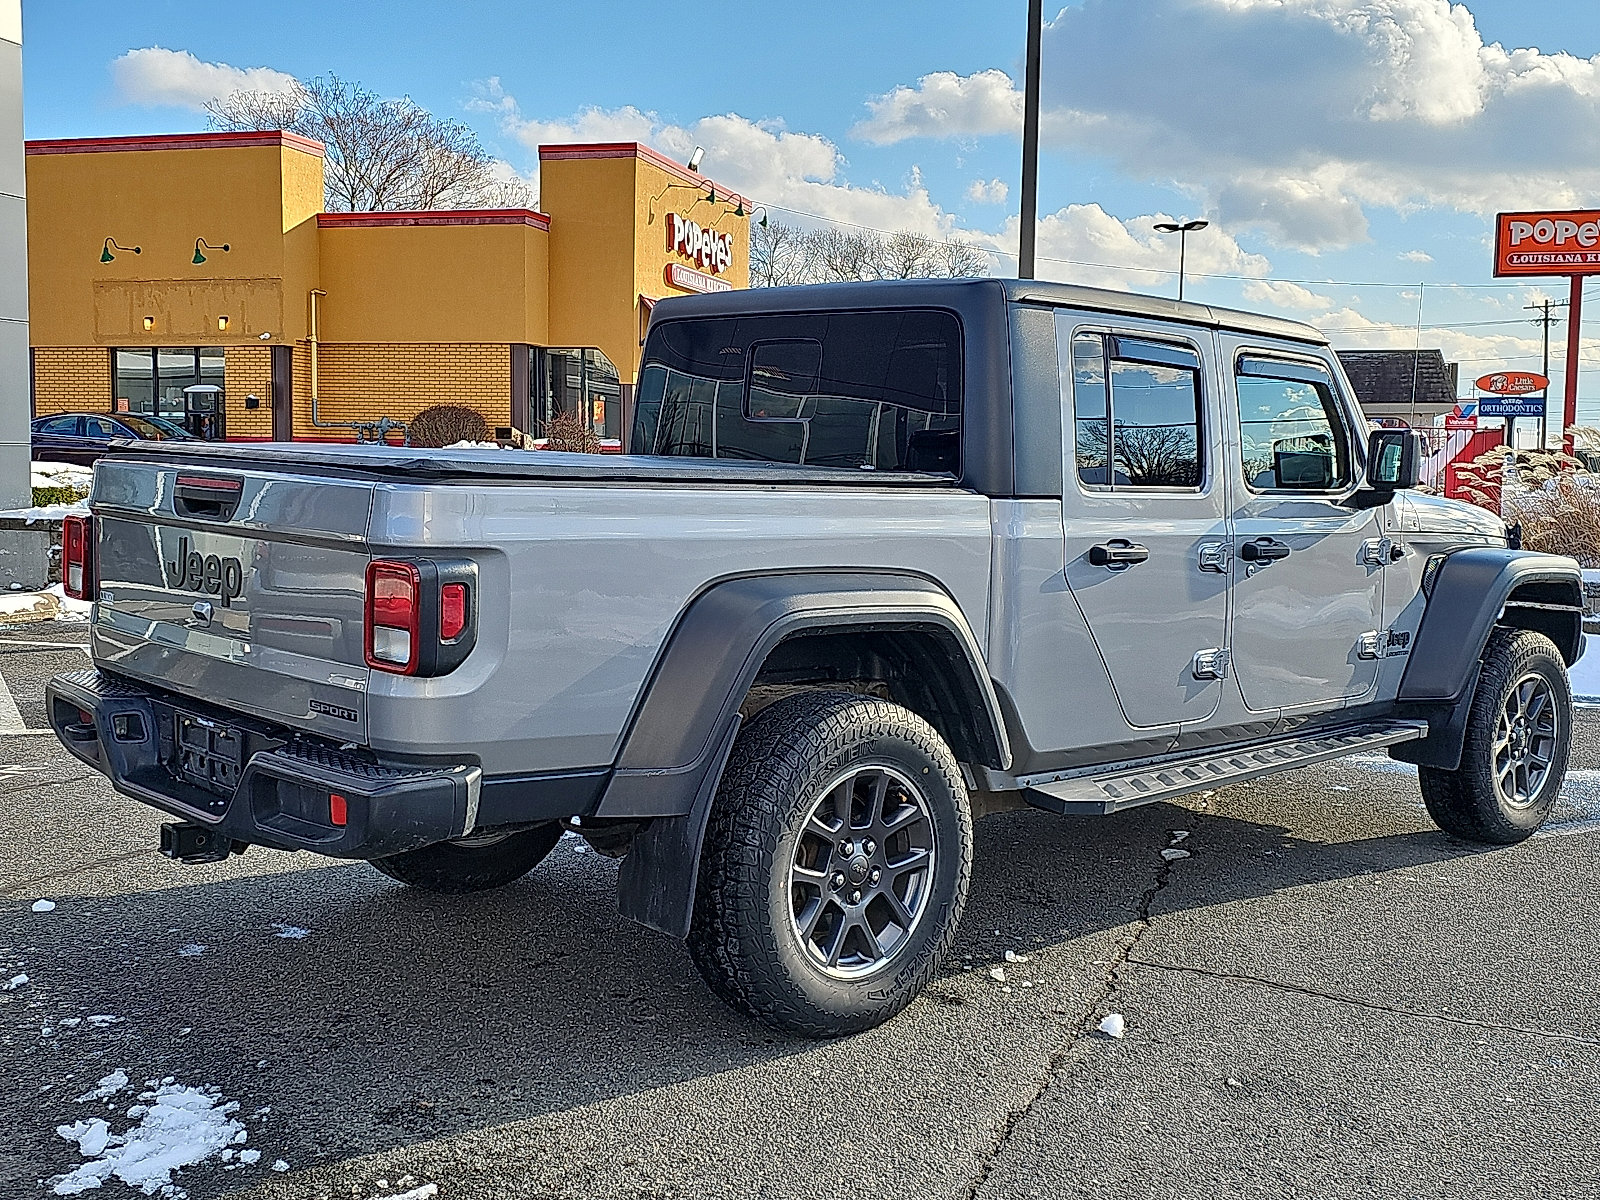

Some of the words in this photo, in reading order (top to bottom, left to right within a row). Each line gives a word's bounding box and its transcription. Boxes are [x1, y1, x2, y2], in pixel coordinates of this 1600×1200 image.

[1512, 253, 1583, 264] LOUISIANA
[1514, 376, 1534, 386] Little
[1508, 383, 1536, 391] Caesars
[1480, 404, 1543, 413] ORTHODONTICS
[167, 536, 243, 607] Jeep
[311, 701, 357, 720] SPORT
